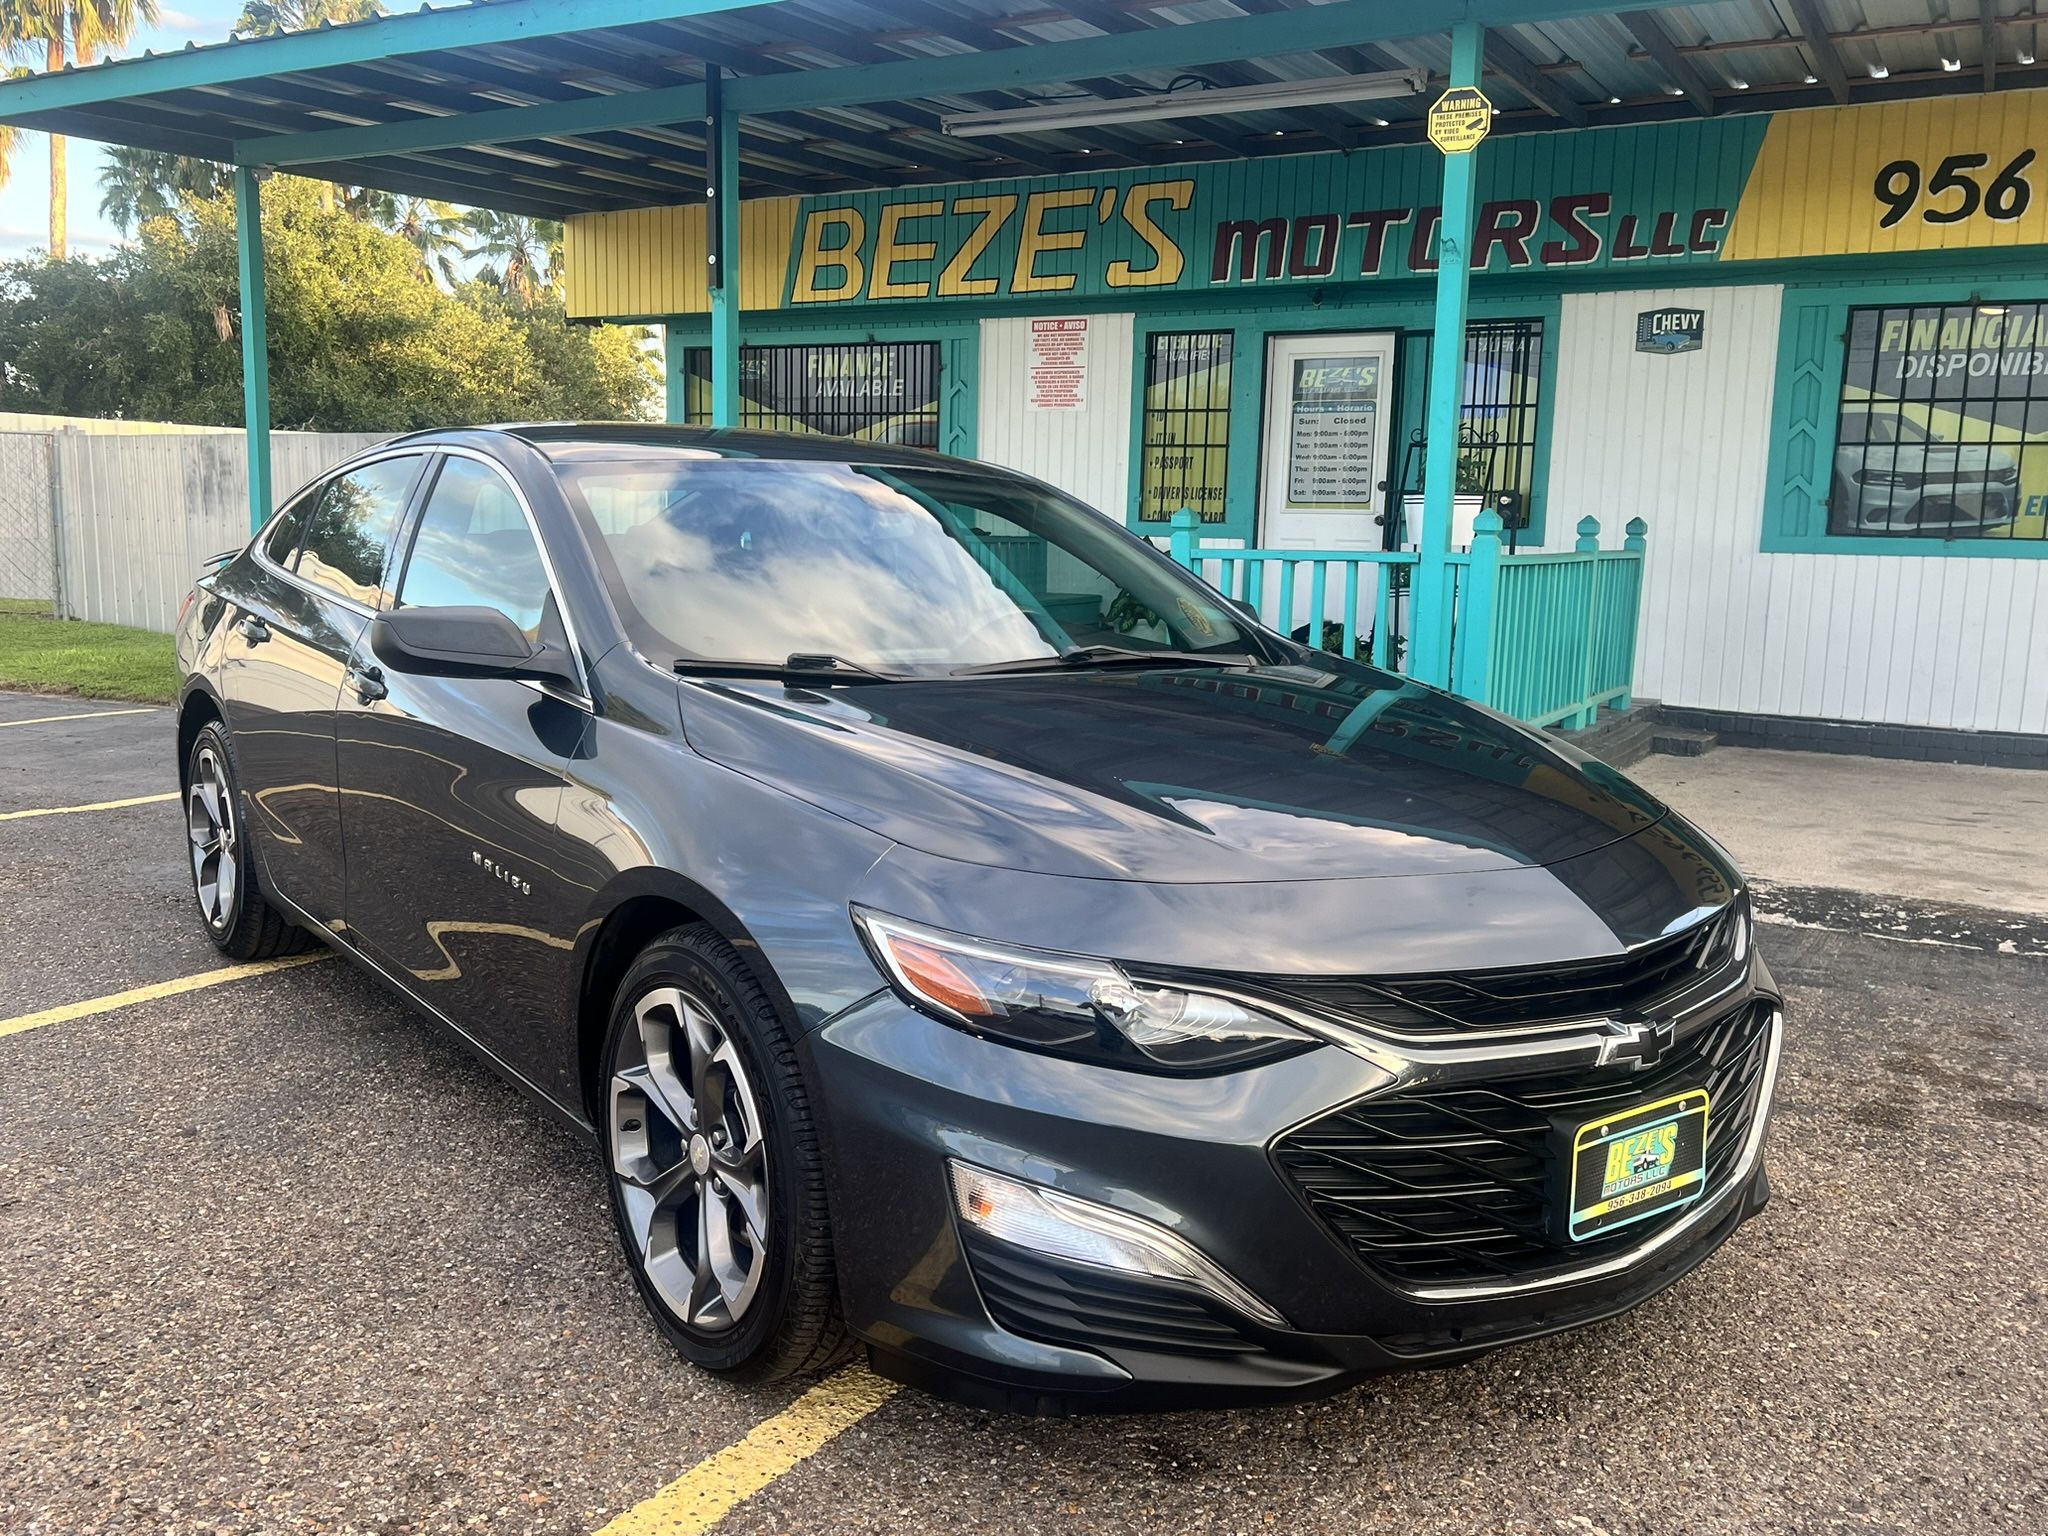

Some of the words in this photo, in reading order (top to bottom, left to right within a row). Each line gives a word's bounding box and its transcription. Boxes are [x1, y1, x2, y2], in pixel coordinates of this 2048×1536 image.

[1441, 98, 1481, 112] WARNING
[1455, 110, 1482, 119] PREMISES
[1435, 120, 1466, 128] PROTECTED
[1440, 133, 1476, 143] SURVEILLANCE
[1874, 148, 2037, 229] 956
[791, 179, 1196, 304] BEZE'S
[1211, 192, 1612, 284] MOTORS
[1612, 208, 1729, 261] LLC
[1033, 321, 1059, 331] NOTICE
[1063, 320, 1086, 330] AVISO
[1652, 313, 1700, 335] CHEVY
[1880, 314, 2048, 352] FINANCIA
[808, 352, 896, 378] FINANCE
[1896, 352, 2048, 379] DISPONIB
[1299, 366, 1377, 388] BEZE'S
[815, 379, 905, 398] AVAILABLE
[1296, 405, 1325, 413] Hours
[1336, 404, 1374, 412] Horario
[1333, 417, 1367, 425] Closed
[1154, 456, 1194, 469] PASSPORT
[1153, 486, 1189, 500] DRIVERS
[1191, 486, 1223, 501] LICENSE
[472, 851, 531, 896] MALIBU
[1606, 1124, 1677, 1184] BEZE'S
[1603, 1173, 1644, 1195] MOTORS
[1646, 1165, 1666, 1180] LLC
[1607, 1180, 1672, 1211] 956-348-2094
